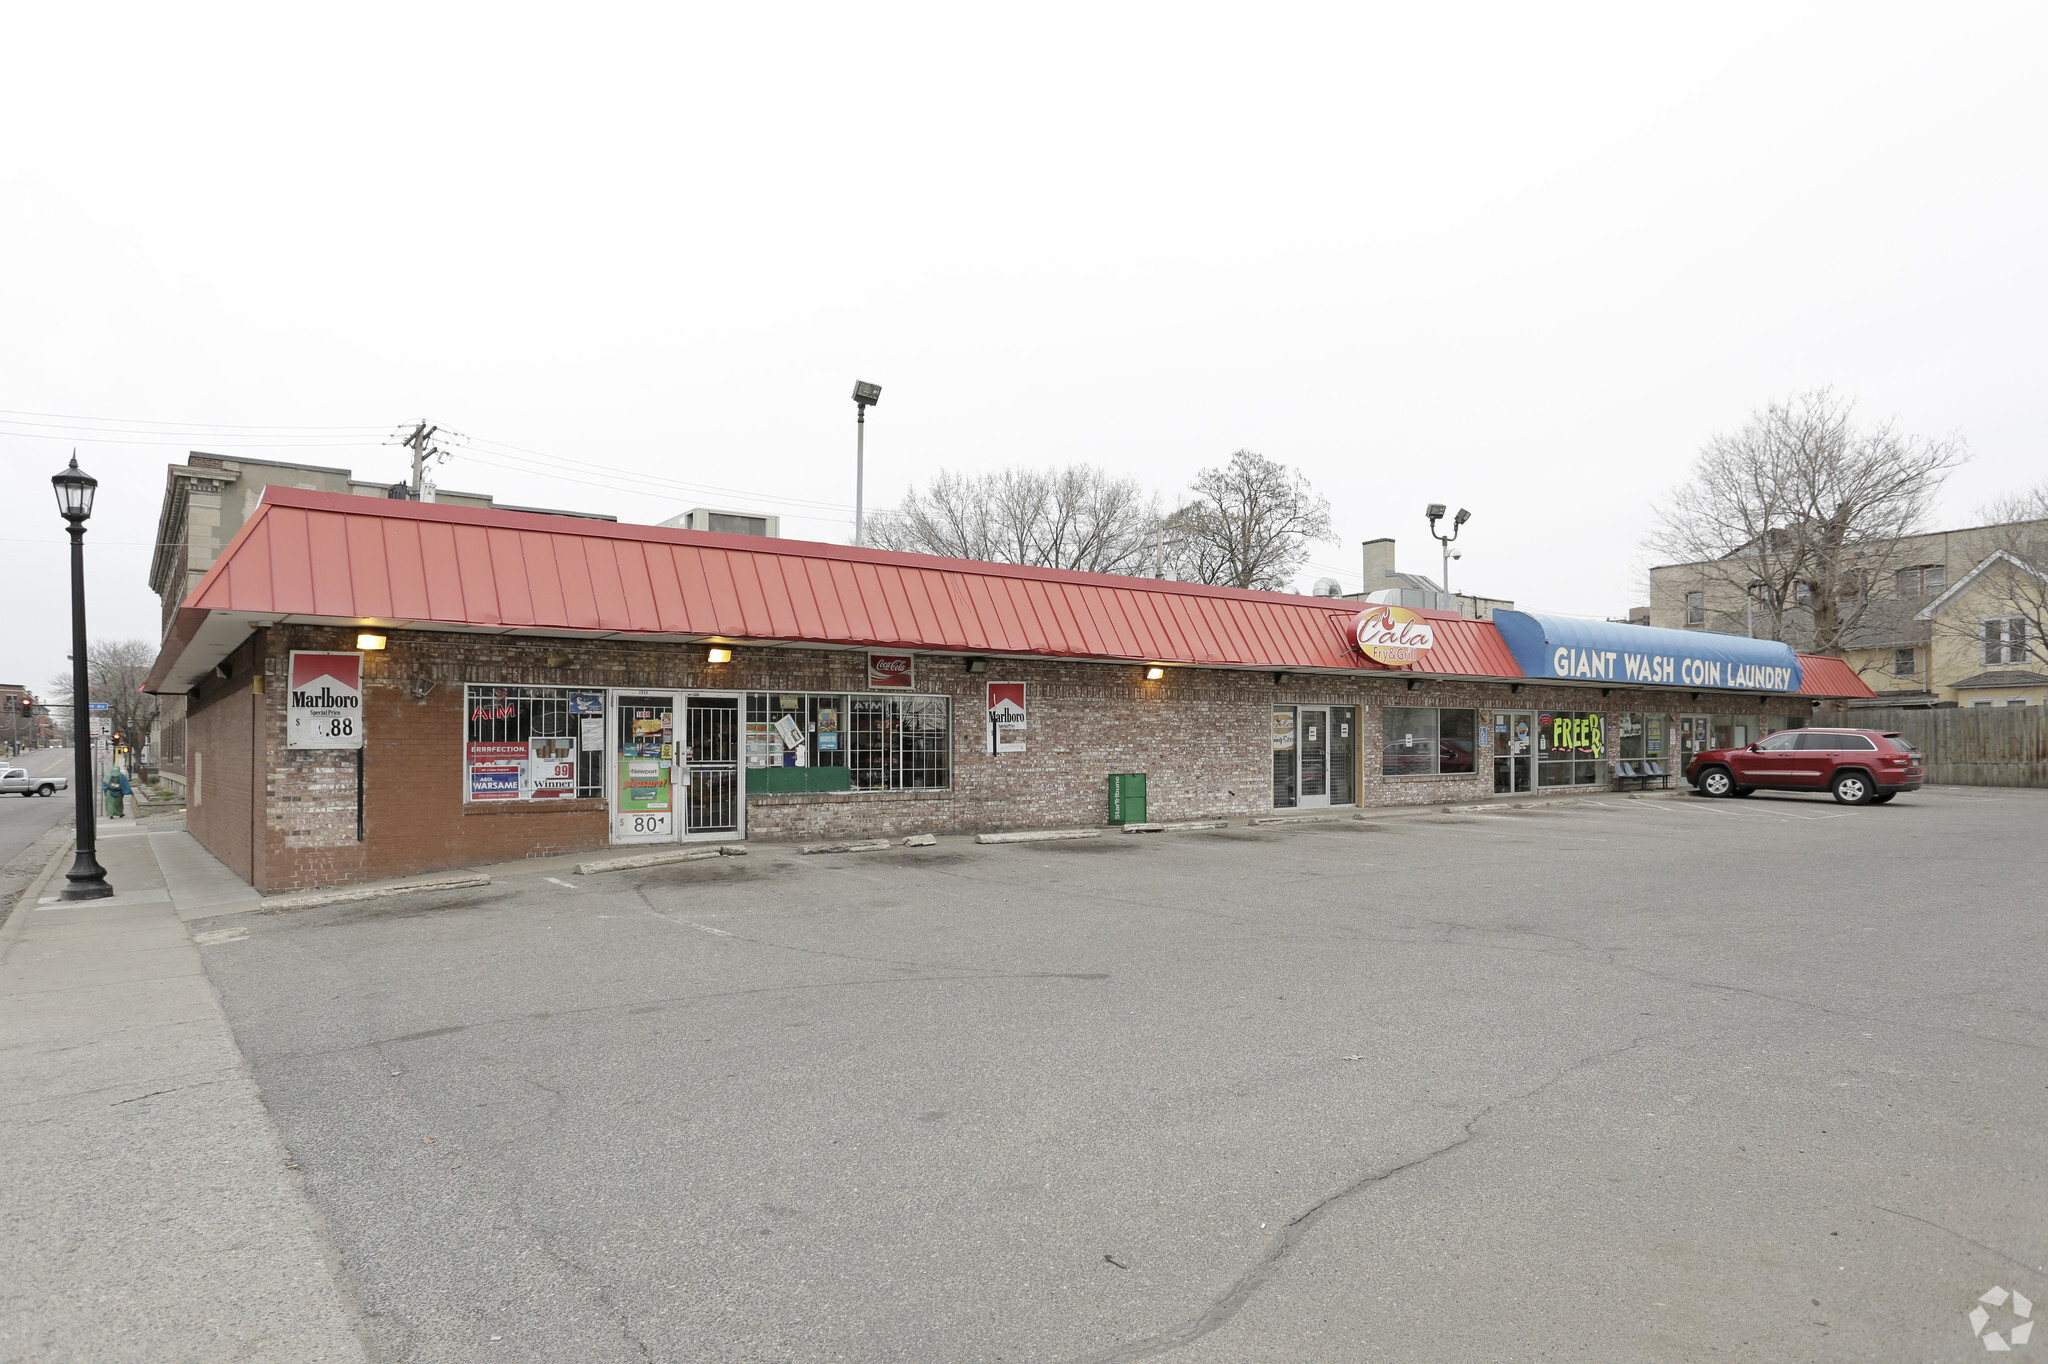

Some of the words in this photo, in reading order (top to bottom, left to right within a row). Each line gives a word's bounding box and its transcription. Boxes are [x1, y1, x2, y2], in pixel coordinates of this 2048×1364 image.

[1358, 613, 1430, 646] Cala
[1553, 647, 1617, 679] GIANT
[1623, 653, 1675, 683] WASH
[1681, 658, 1721, 687] COIN
[1727, 662, 1791, 690] LAUNDRY
[291, 687, 359, 708] Marlboro
[853, 701, 882, 710] ATM
[471, 703, 516, 721] ATM
[989, 707, 1025, 723] Marlboro
[1553, 717, 1590, 749] FREE
[472, 782, 518, 790] WARSAME
[534, 780, 572, 788] Winner
[622, 779, 667, 790] pleasure!
